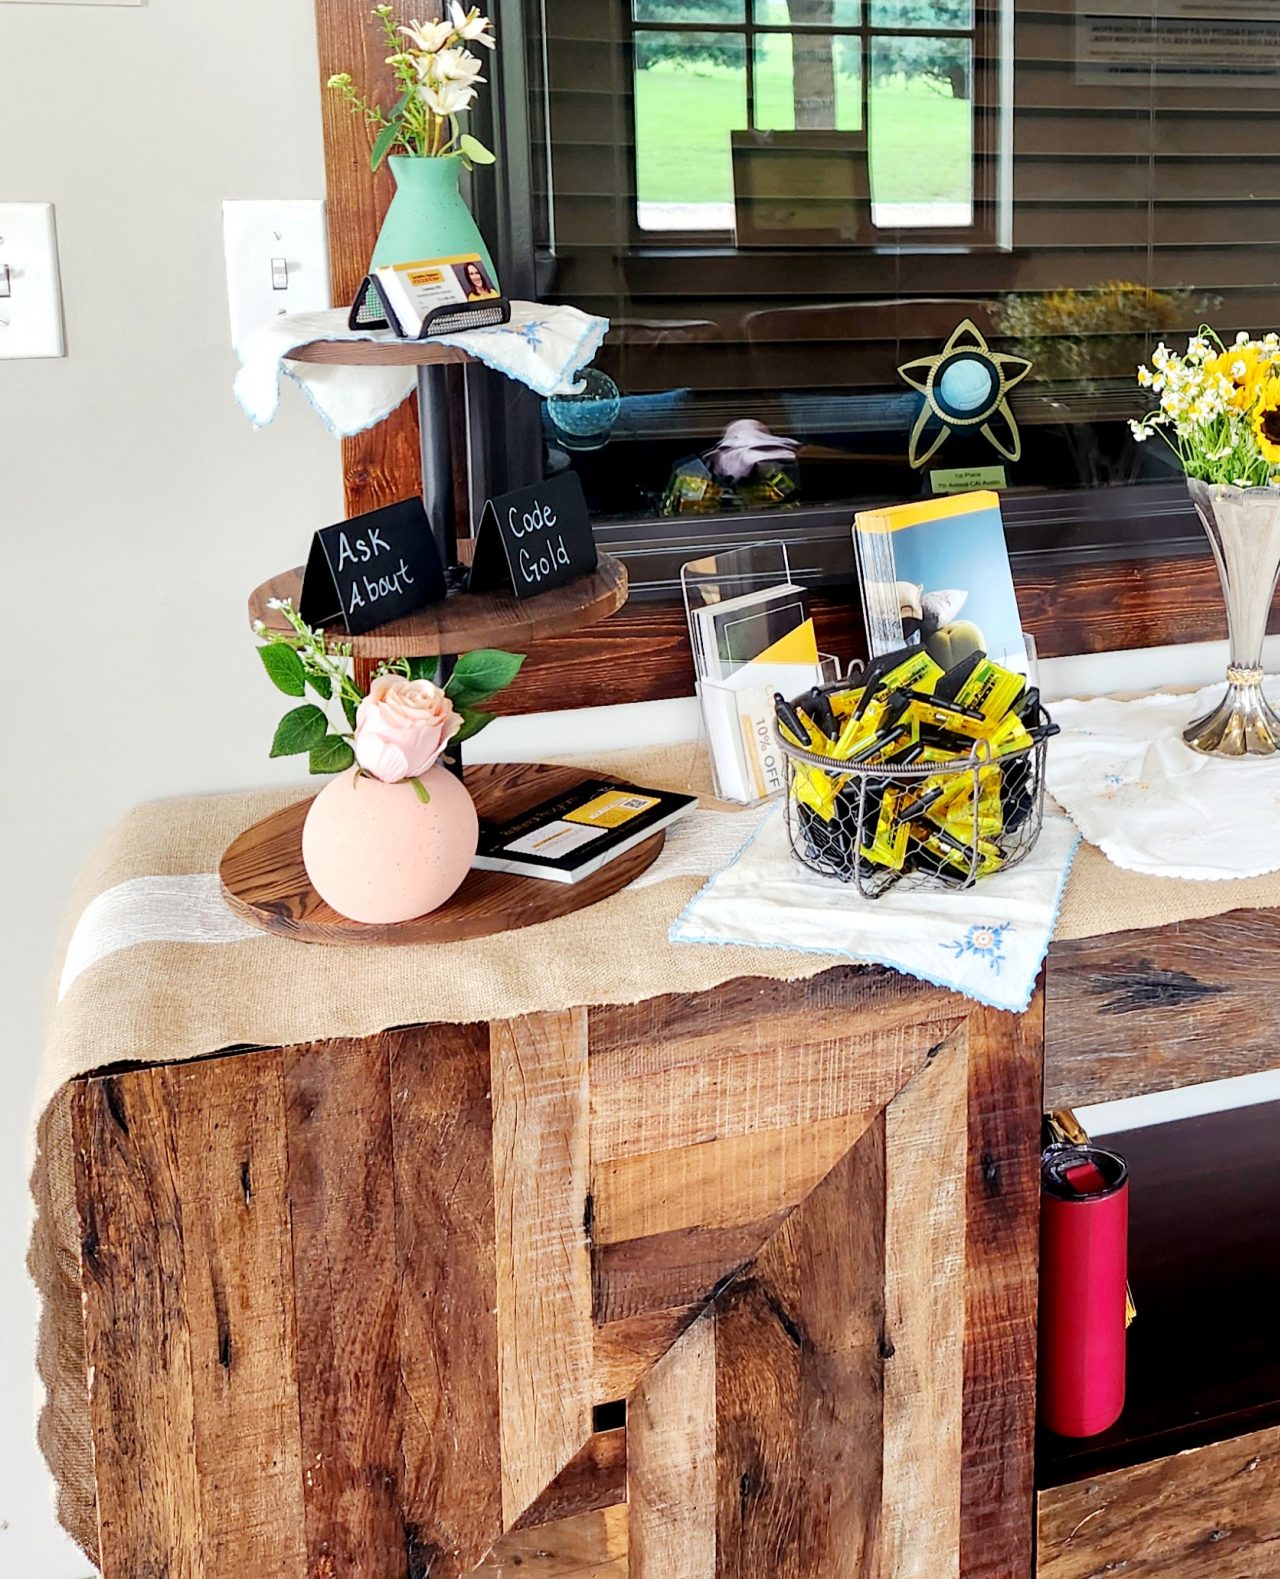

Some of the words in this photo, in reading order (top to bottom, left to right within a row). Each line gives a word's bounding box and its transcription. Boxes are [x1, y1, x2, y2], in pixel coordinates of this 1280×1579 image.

[508, 500, 558, 539] Code
[337, 527, 391, 572] Ask
[519, 534, 570, 583] Gold
[349, 558, 414, 614] About
[756, 717, 772, 752] 10%
[764, 755, 781, 788] OFF
